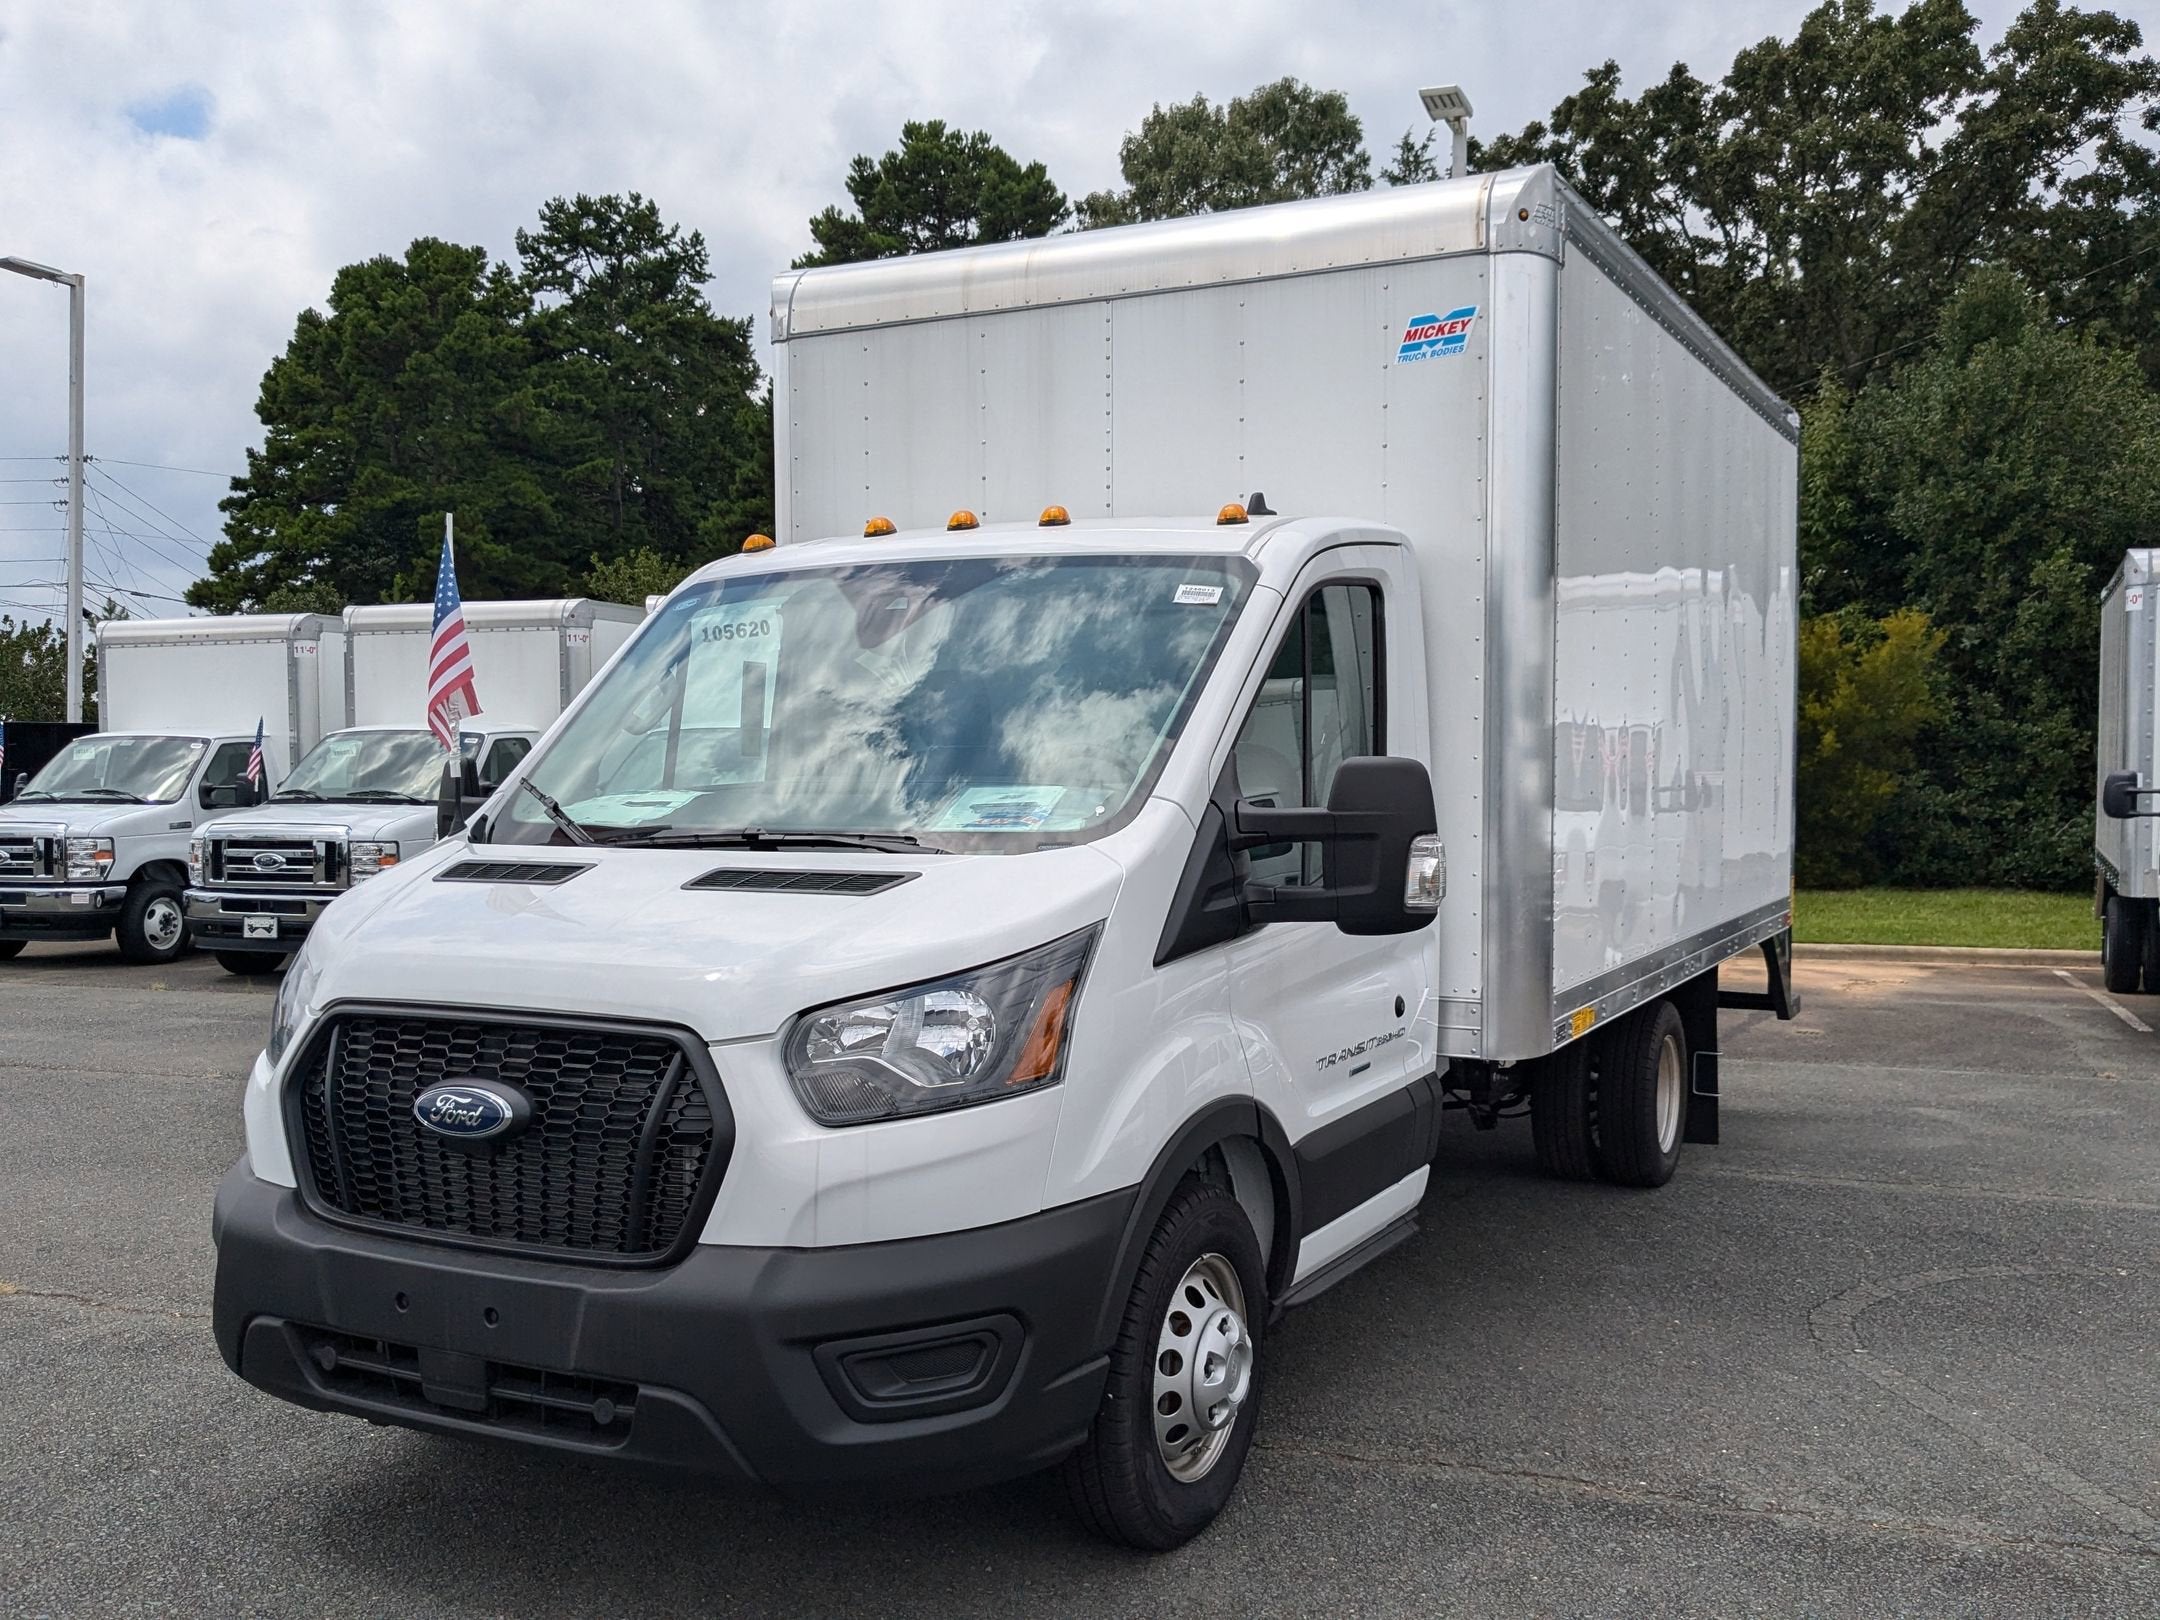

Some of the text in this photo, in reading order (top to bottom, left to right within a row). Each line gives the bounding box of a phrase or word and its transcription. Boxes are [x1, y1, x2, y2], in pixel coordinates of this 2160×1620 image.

[1403, 318, 1472, 343] MICKEY
[1397, 344, 1464, 363] TRUCK BODIES
[702, 619, 770, 643] 105620
[1316, 1036, 1377, 1071] TRANSIT
[430, 1094, 484, 1127] Ford
